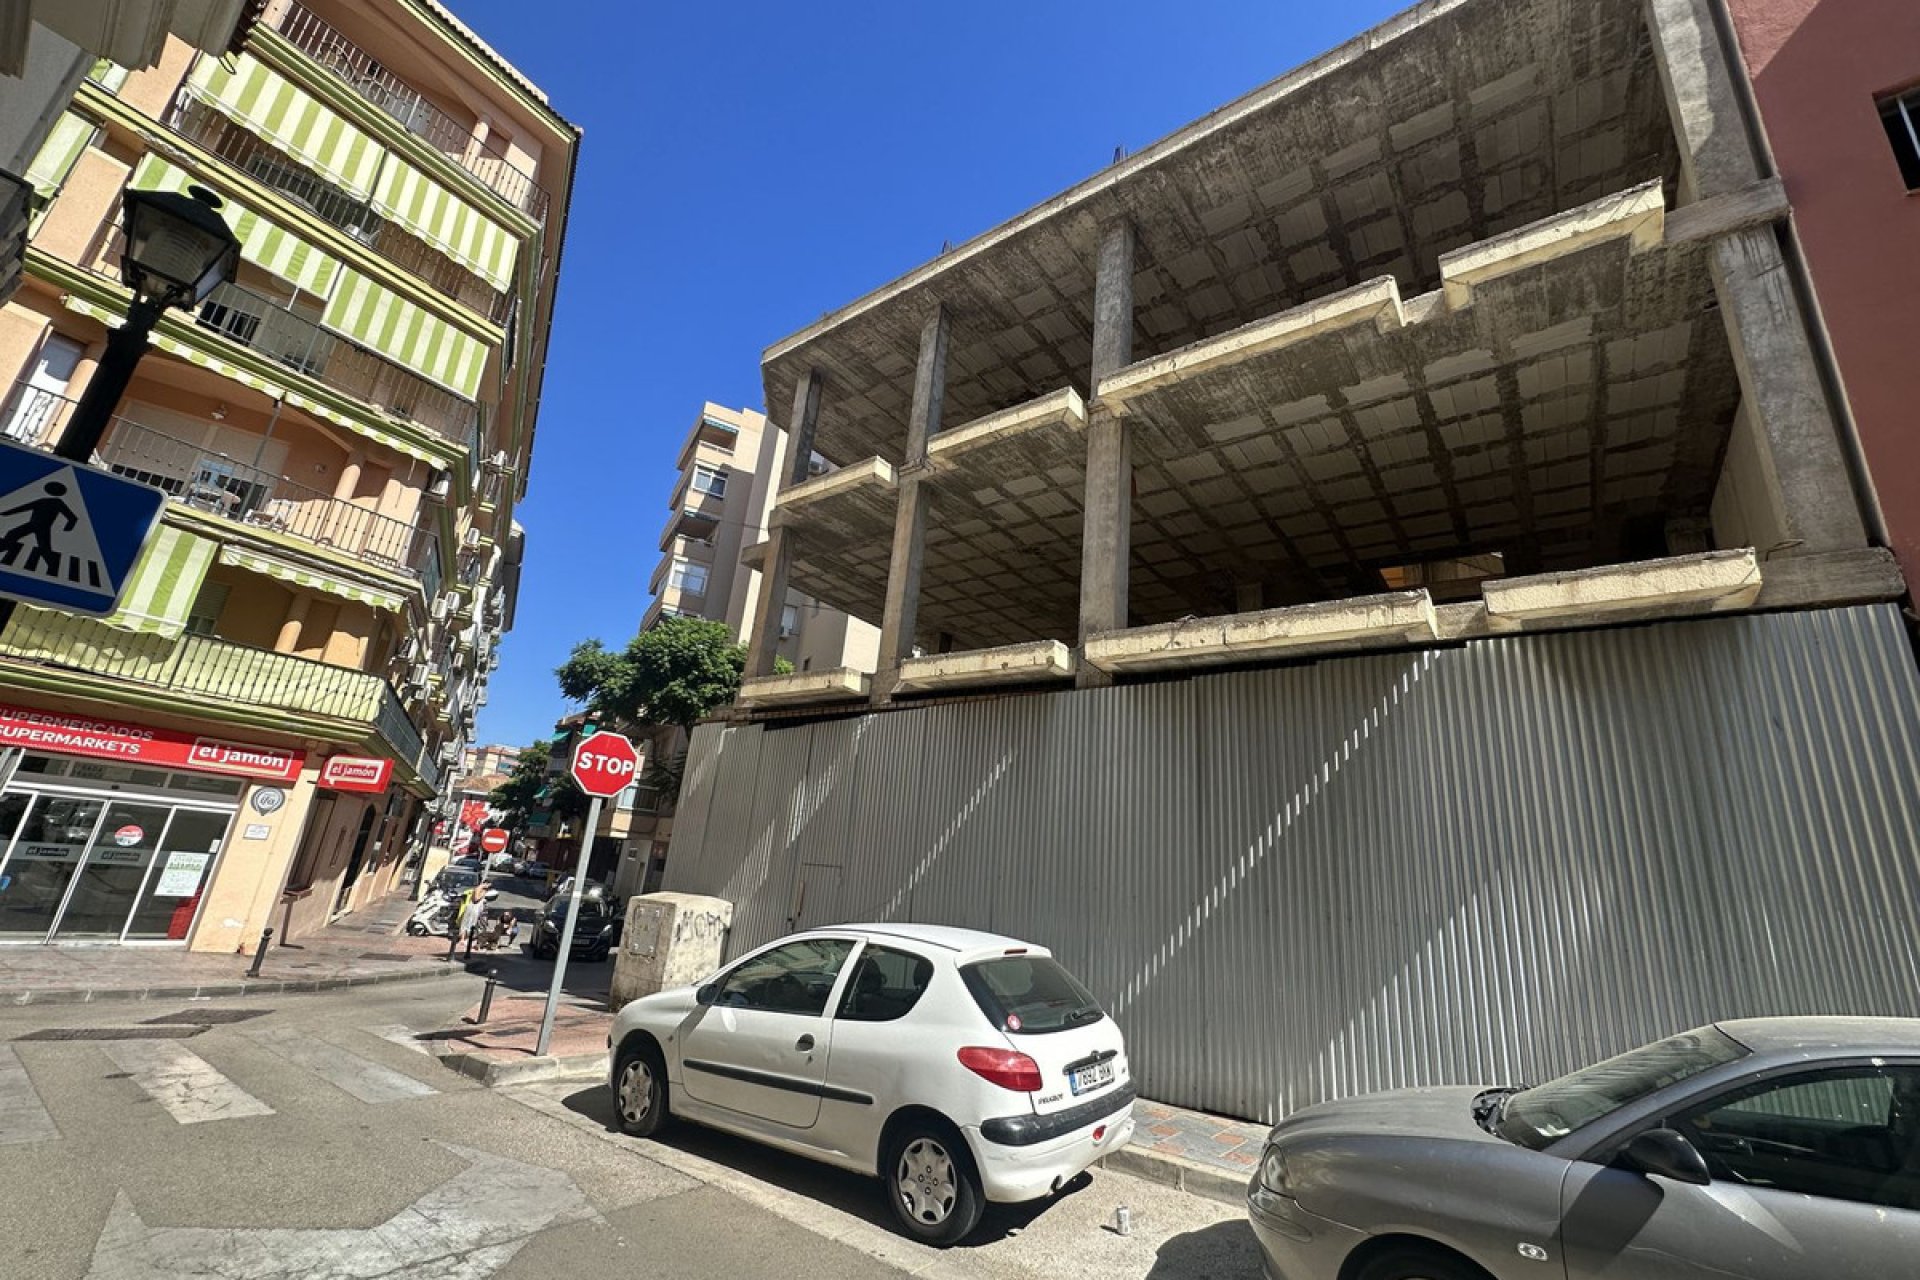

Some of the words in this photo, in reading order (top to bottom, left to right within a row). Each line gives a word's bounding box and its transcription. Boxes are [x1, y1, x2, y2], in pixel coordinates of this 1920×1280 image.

[0, 708, 154, 741] UPERMERCADOS
[199, 744, 218, 759] el
[219, 747, 285, 768] jamón
[332, 763, 342, 773] el
[578, 752, 634, 776] STOP
